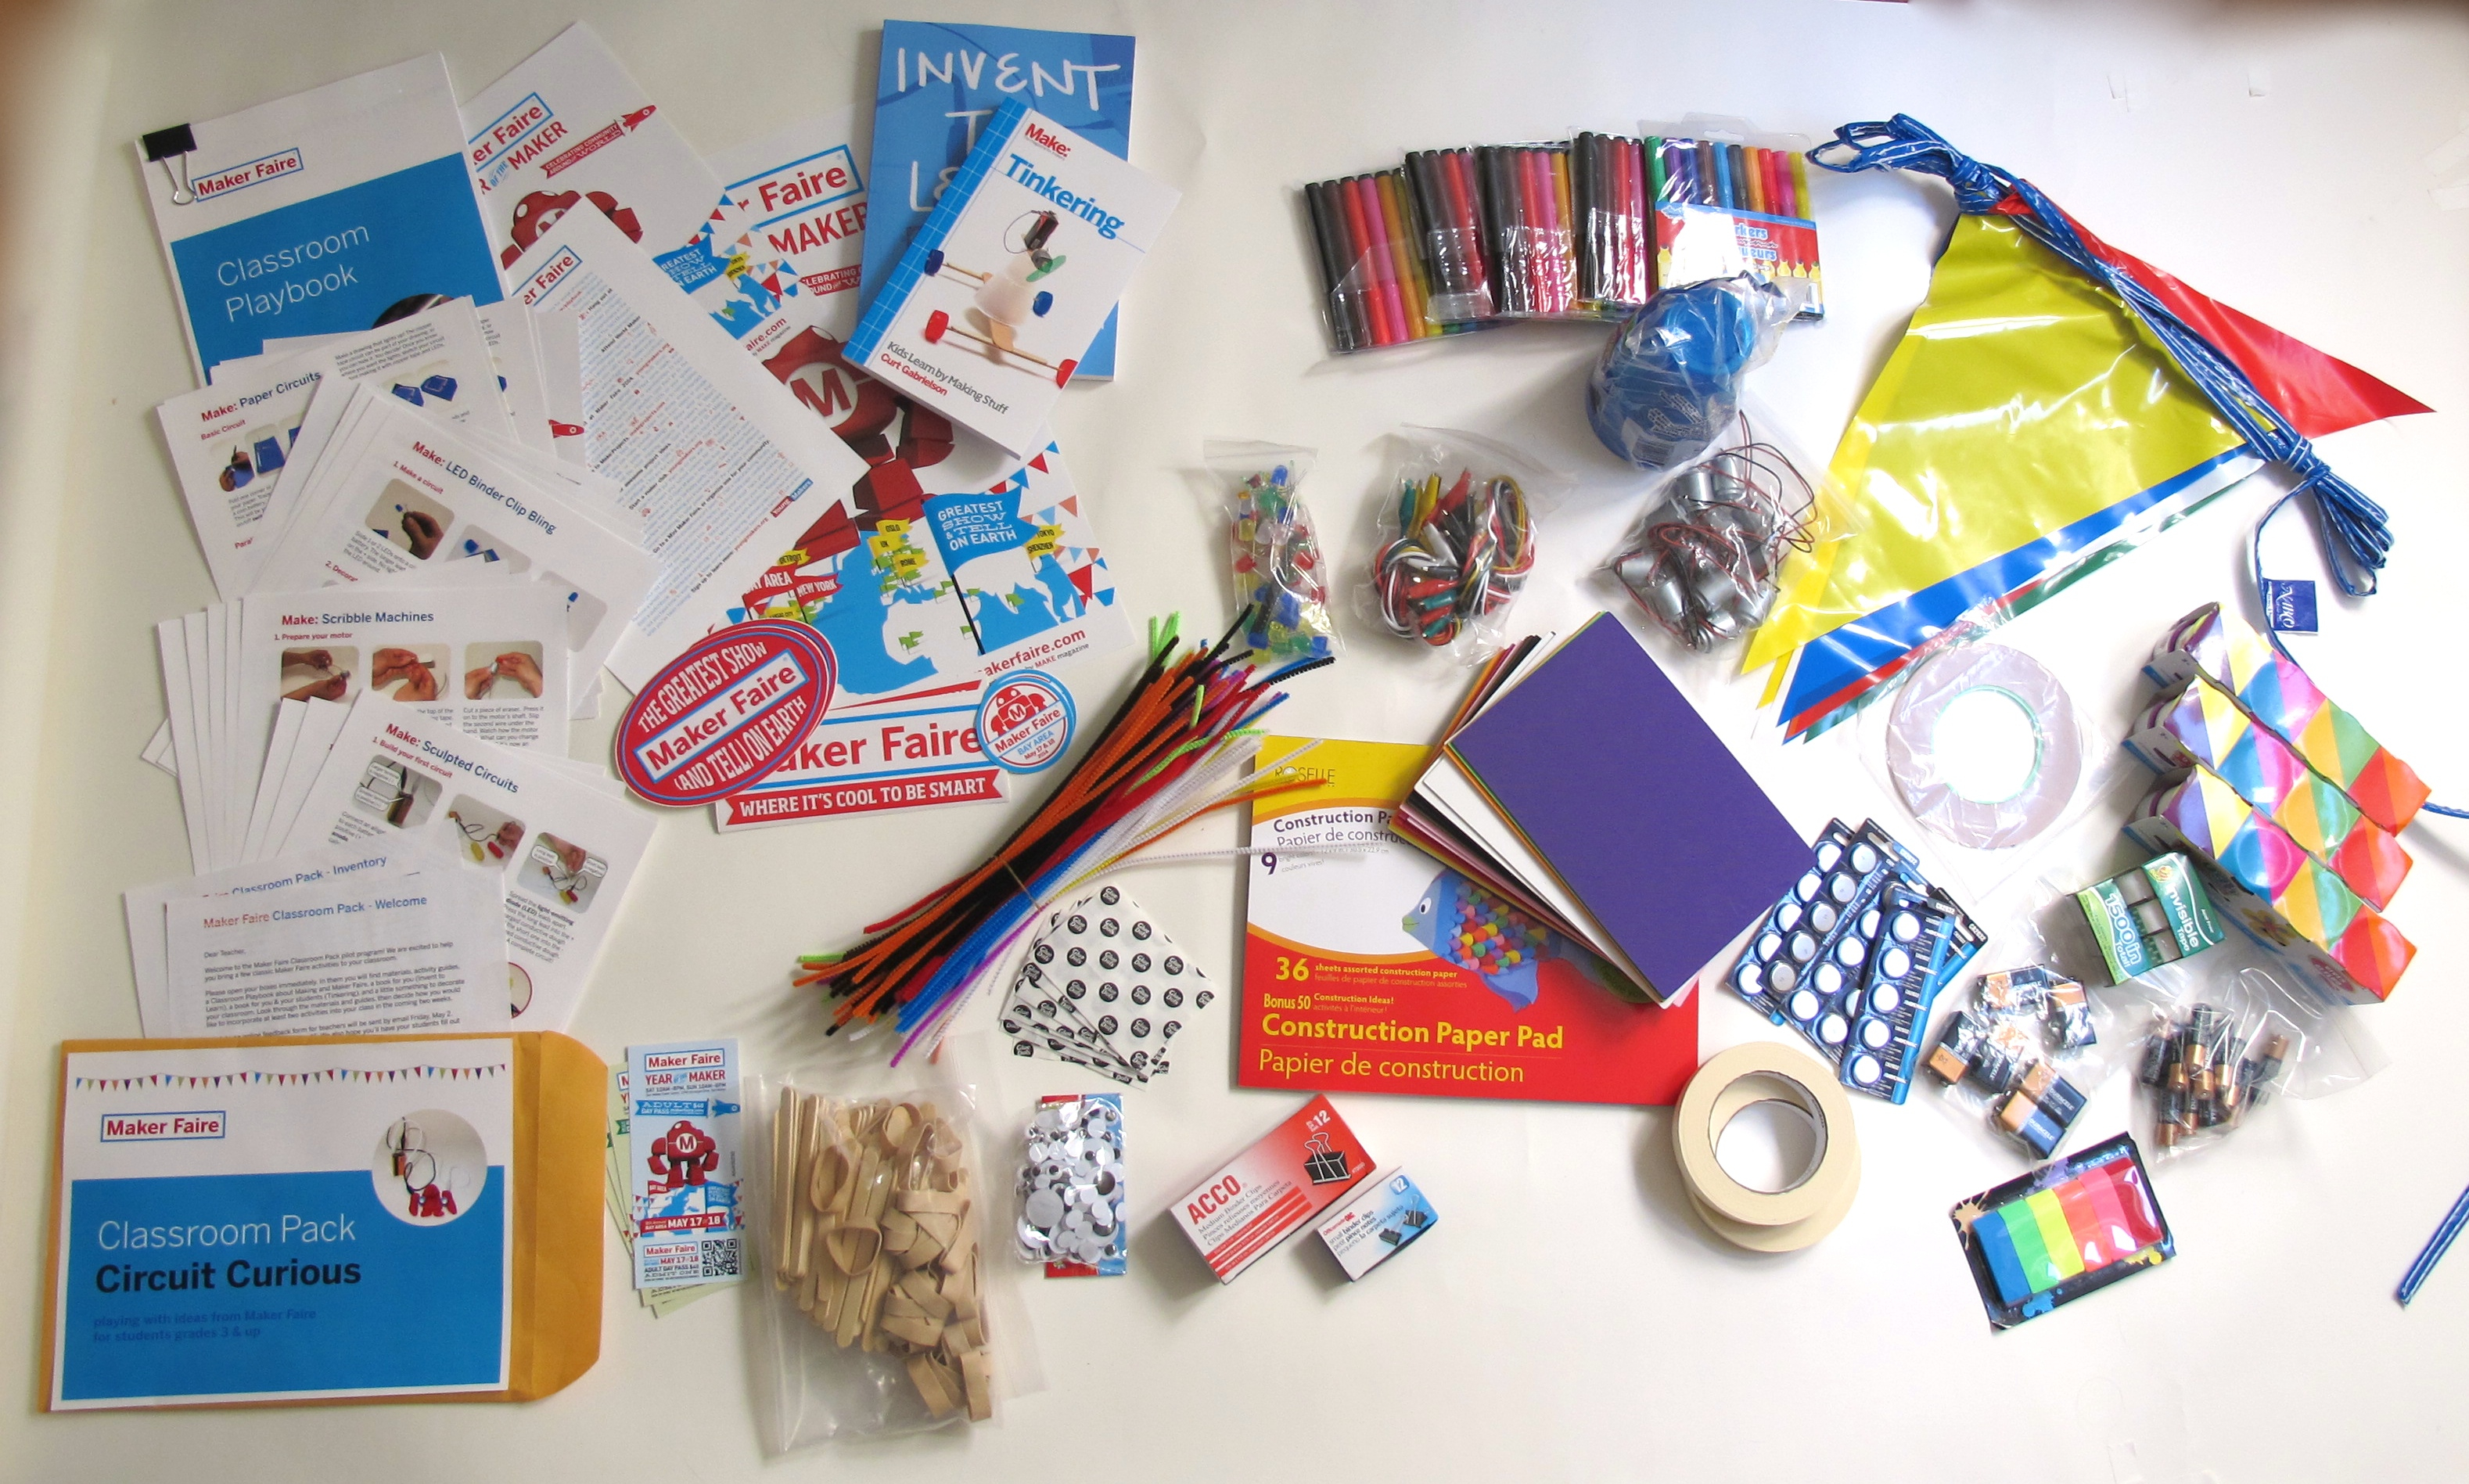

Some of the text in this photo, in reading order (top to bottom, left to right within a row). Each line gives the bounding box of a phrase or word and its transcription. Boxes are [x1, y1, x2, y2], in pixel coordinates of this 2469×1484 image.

[897, 48, 1121, 111] INVENT
[493, 106, 542, 145] Faire
[507, 121, 568, 170] MAKER
[1025, 123, 1072, 157] Make:
[198, 156, 297, 196] Maker Faire
[758, 167, 848, 213] Faire
[1004, 153, 1125, 240] Tinkering
[218, 225, 369, 286] Classroom
[536, 255, 574, 293] Faire
[226, 264, 358, 322] Playbook
[881, 353, 948, 396] Curt Gabrielson
[887, 341, 1009, 415] Kids Learn by Making Stuff
[201, 372, 322, 422] Make: Paper Circuits
[201, 419, 246, 440] Basic Circuit
[412, 441, 557, 535] Make: LED Binder Clip Bling
[938, 501, 1004, 522] GREATEST
[942, 512, 1006, 531] SHOW
[949, 530, 1018, 551] ON EARTH
[953, 523, 1013, 535] TELL
[796, 579, 837, 597] NEW YORK
[282, 611, 434, 625] Make: Scribble Machines
[1034, 643, 1089, 668] MAKE magazine
[638, 641, 767, 733] THE GREATEST SHOW
[645, 667, 796, 771] Maker Faire
[994, 709, 1061, 753] Maker Faire
[674, 695, 807, 791] (AND TELL) ON EARTH
[1017, 730, 1055, 756] BAY AREA
[379, 739, 397, 753] Build
[397, 748, 415, 760] your
[415, 756, 429, 768] first
[430, 764, 453, 778] circuit
[386, 724, 421, 746] Make:
[422, 740, 474, 772] Sculpted
[474, 765, 519, 793] Circuits
[739, 778, 986, 819] WHERE IT'S COOL TO BE SMART
[1274, 810, 1373, 832] Construction
[296, 869, 323, 883] Pack
[333, 857, 387, 875] Inventory
[1261, 852, 1278, 875] 9
[203, 916, 239, 929] Maker
[243, 913, 269, 924] Faire
[273, 907, 334, 922] Classroom
[337, 902, 365, 914] Pack
[376, 897, 427, 909] Welcome
[1275, 957, 1310, 981] 36
[1315, 962, 1458, 979] sheets assorted construction paper
[1391, 978, 1436, 987] construction
[1263, 993, 1311, 1010] Bonus 50
[1314, 992, 1394, 1004] Construction Ideas!
[1262, 1012, 1564, 1052] Construction Paper Pad
[649, 1053, 721, 1068] Maker Faire
[1259, 1048, 1525, 1082] Papier de construction
[645, 1073, 672, 1085] YEAR
[689, 1069, 726, 1082] MAKER
[106, 1117, 219, 1136] Maker Faire
[1314, 1109, 1332, 1126] 12
[2029, 1118, 2055, 1141] DURACELL
[1245, 1184, 1263, 1199] Clips
[1393, 1177, 1408, 1193] 12
[1187, 1174, 1242, 1225] ACCO
[99, 1213, 356, 1250] Classroom Pack
[667, 1216, 703, 1227] MAY 17
[708, 1216, 721, 1225] 18
[646, 1246, 673, 1255] Maker
[96, 1258, 361, 1293] Circuit Curious
[93, 1308, 316, 1328] playing with ideas from Maker Faire
[93, 1327, 261, 1342] for students grades 3 & up
